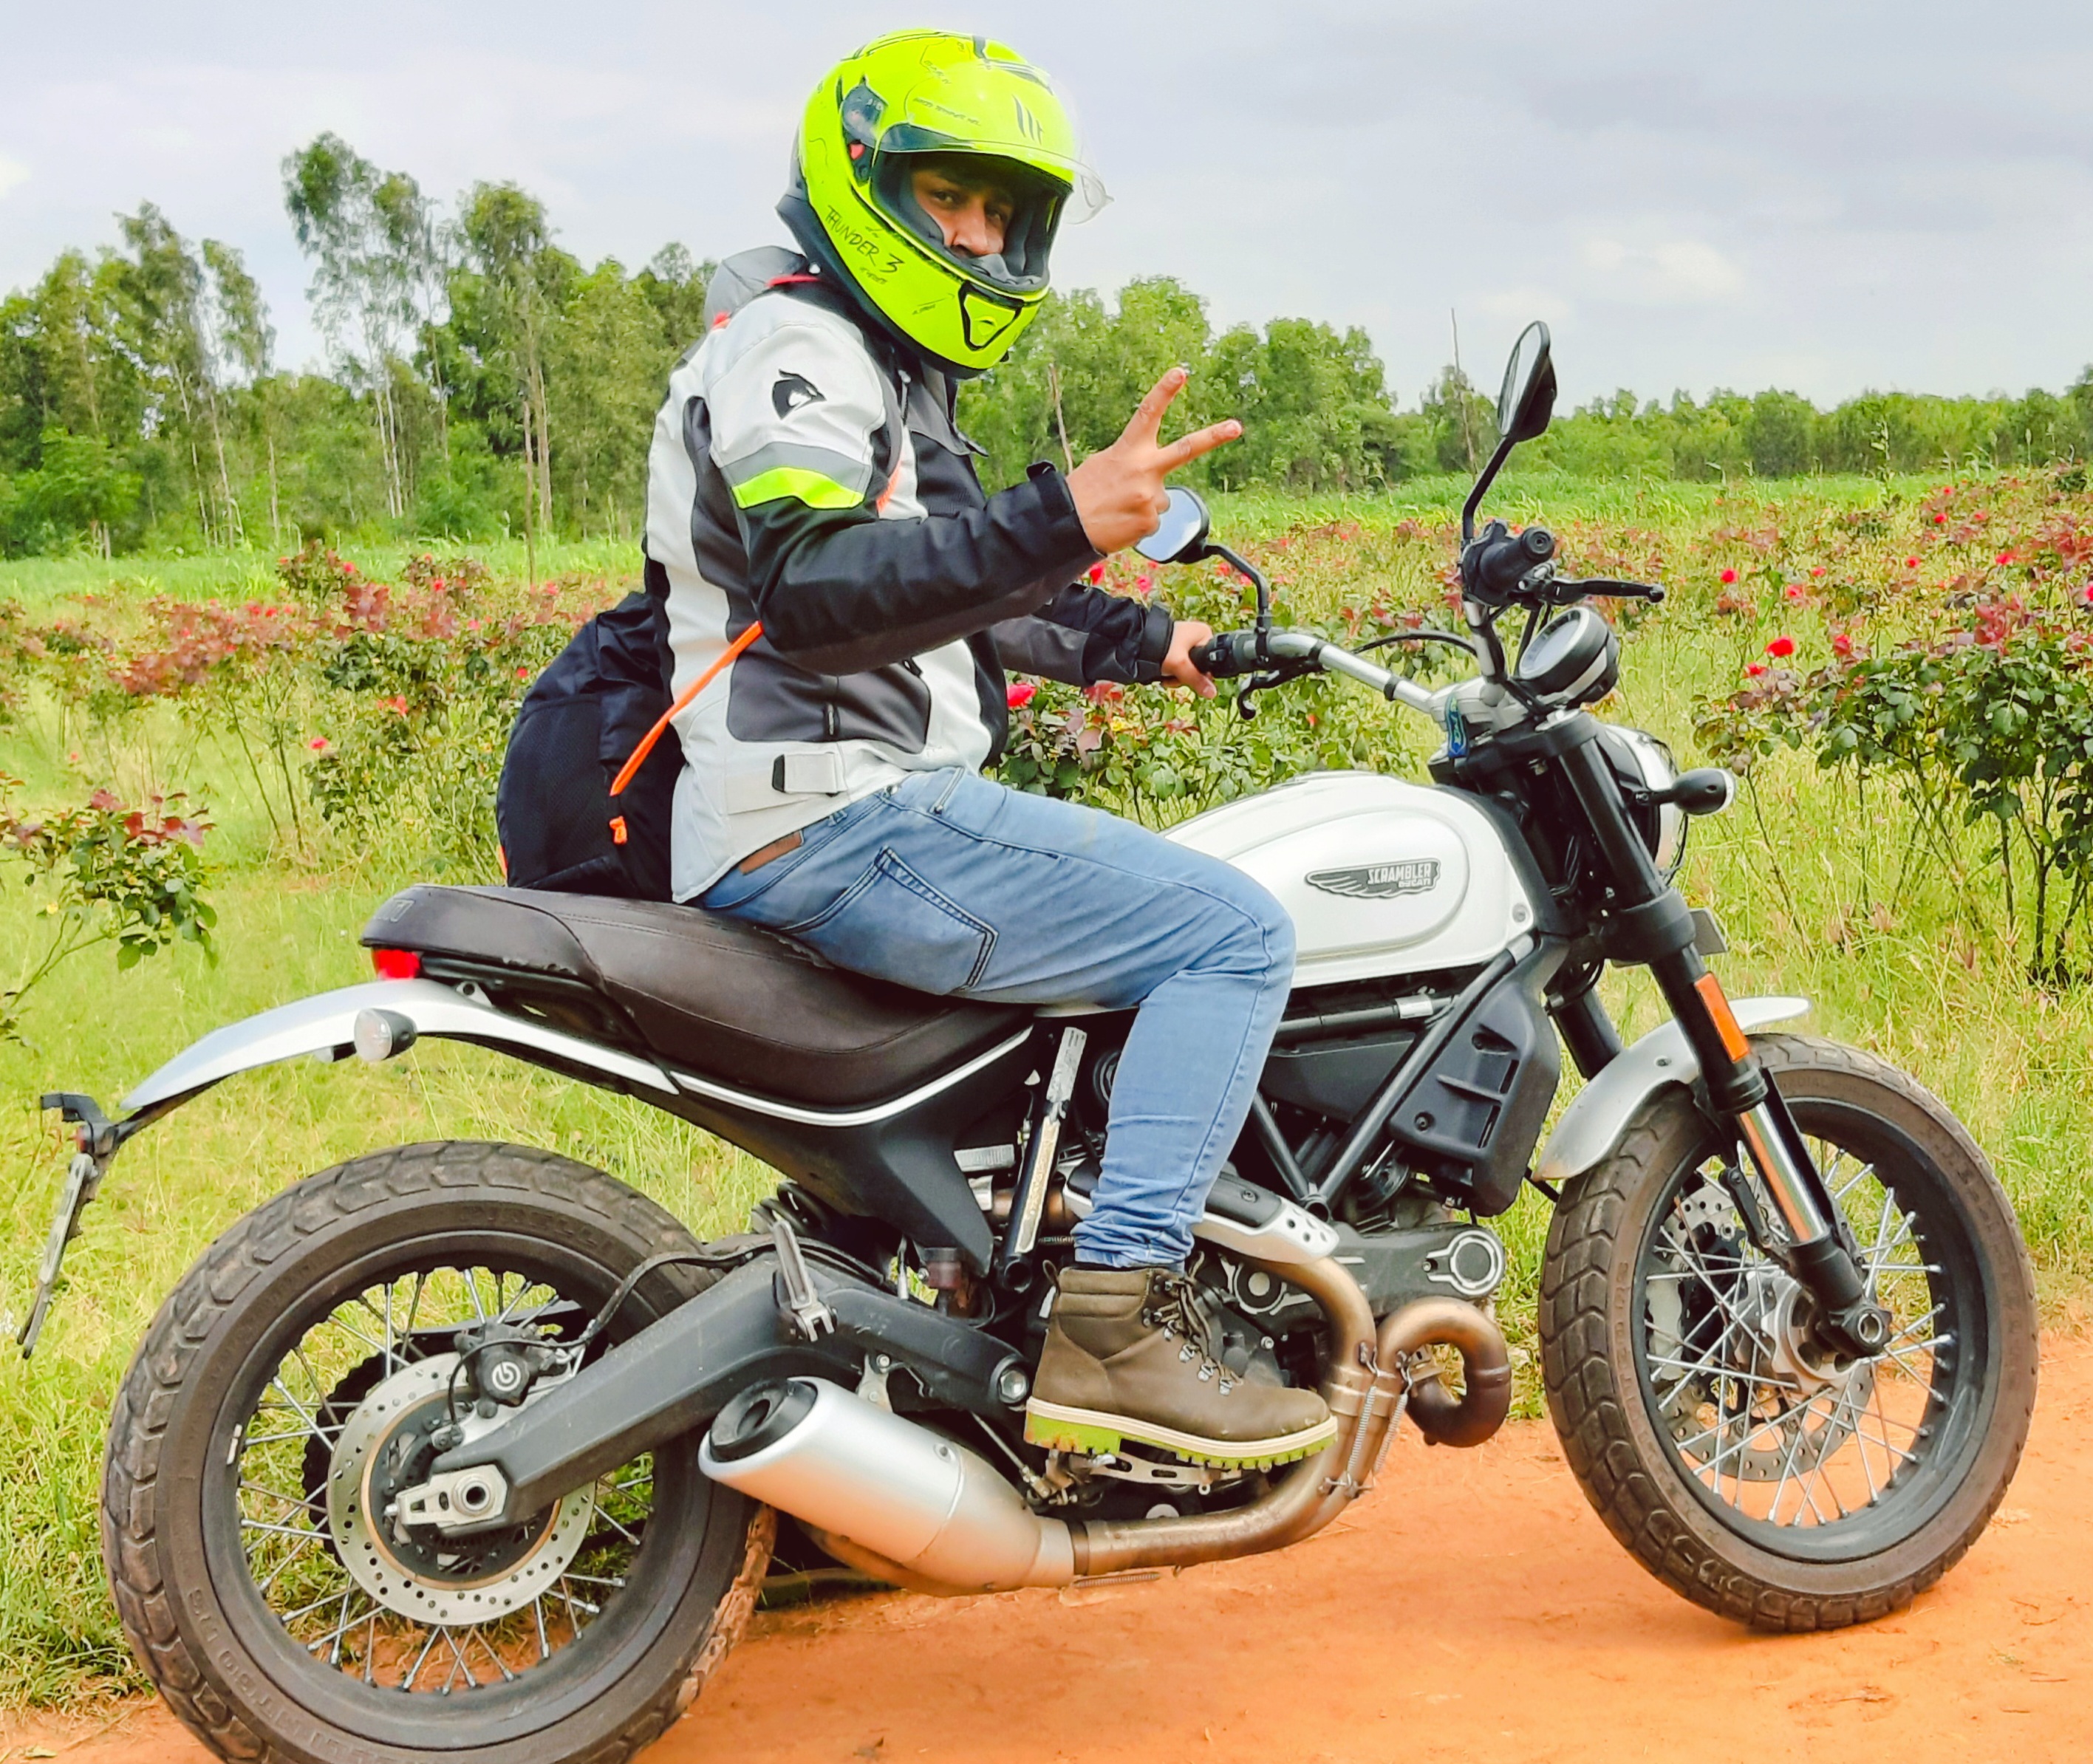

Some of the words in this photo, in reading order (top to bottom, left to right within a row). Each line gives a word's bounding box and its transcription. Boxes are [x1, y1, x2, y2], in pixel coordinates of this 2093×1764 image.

[825, 205, 879, 266] THUNDER
[879, 253, 905, 273] 3
[1368, 863, 1432, 884] SCRAMBLER
